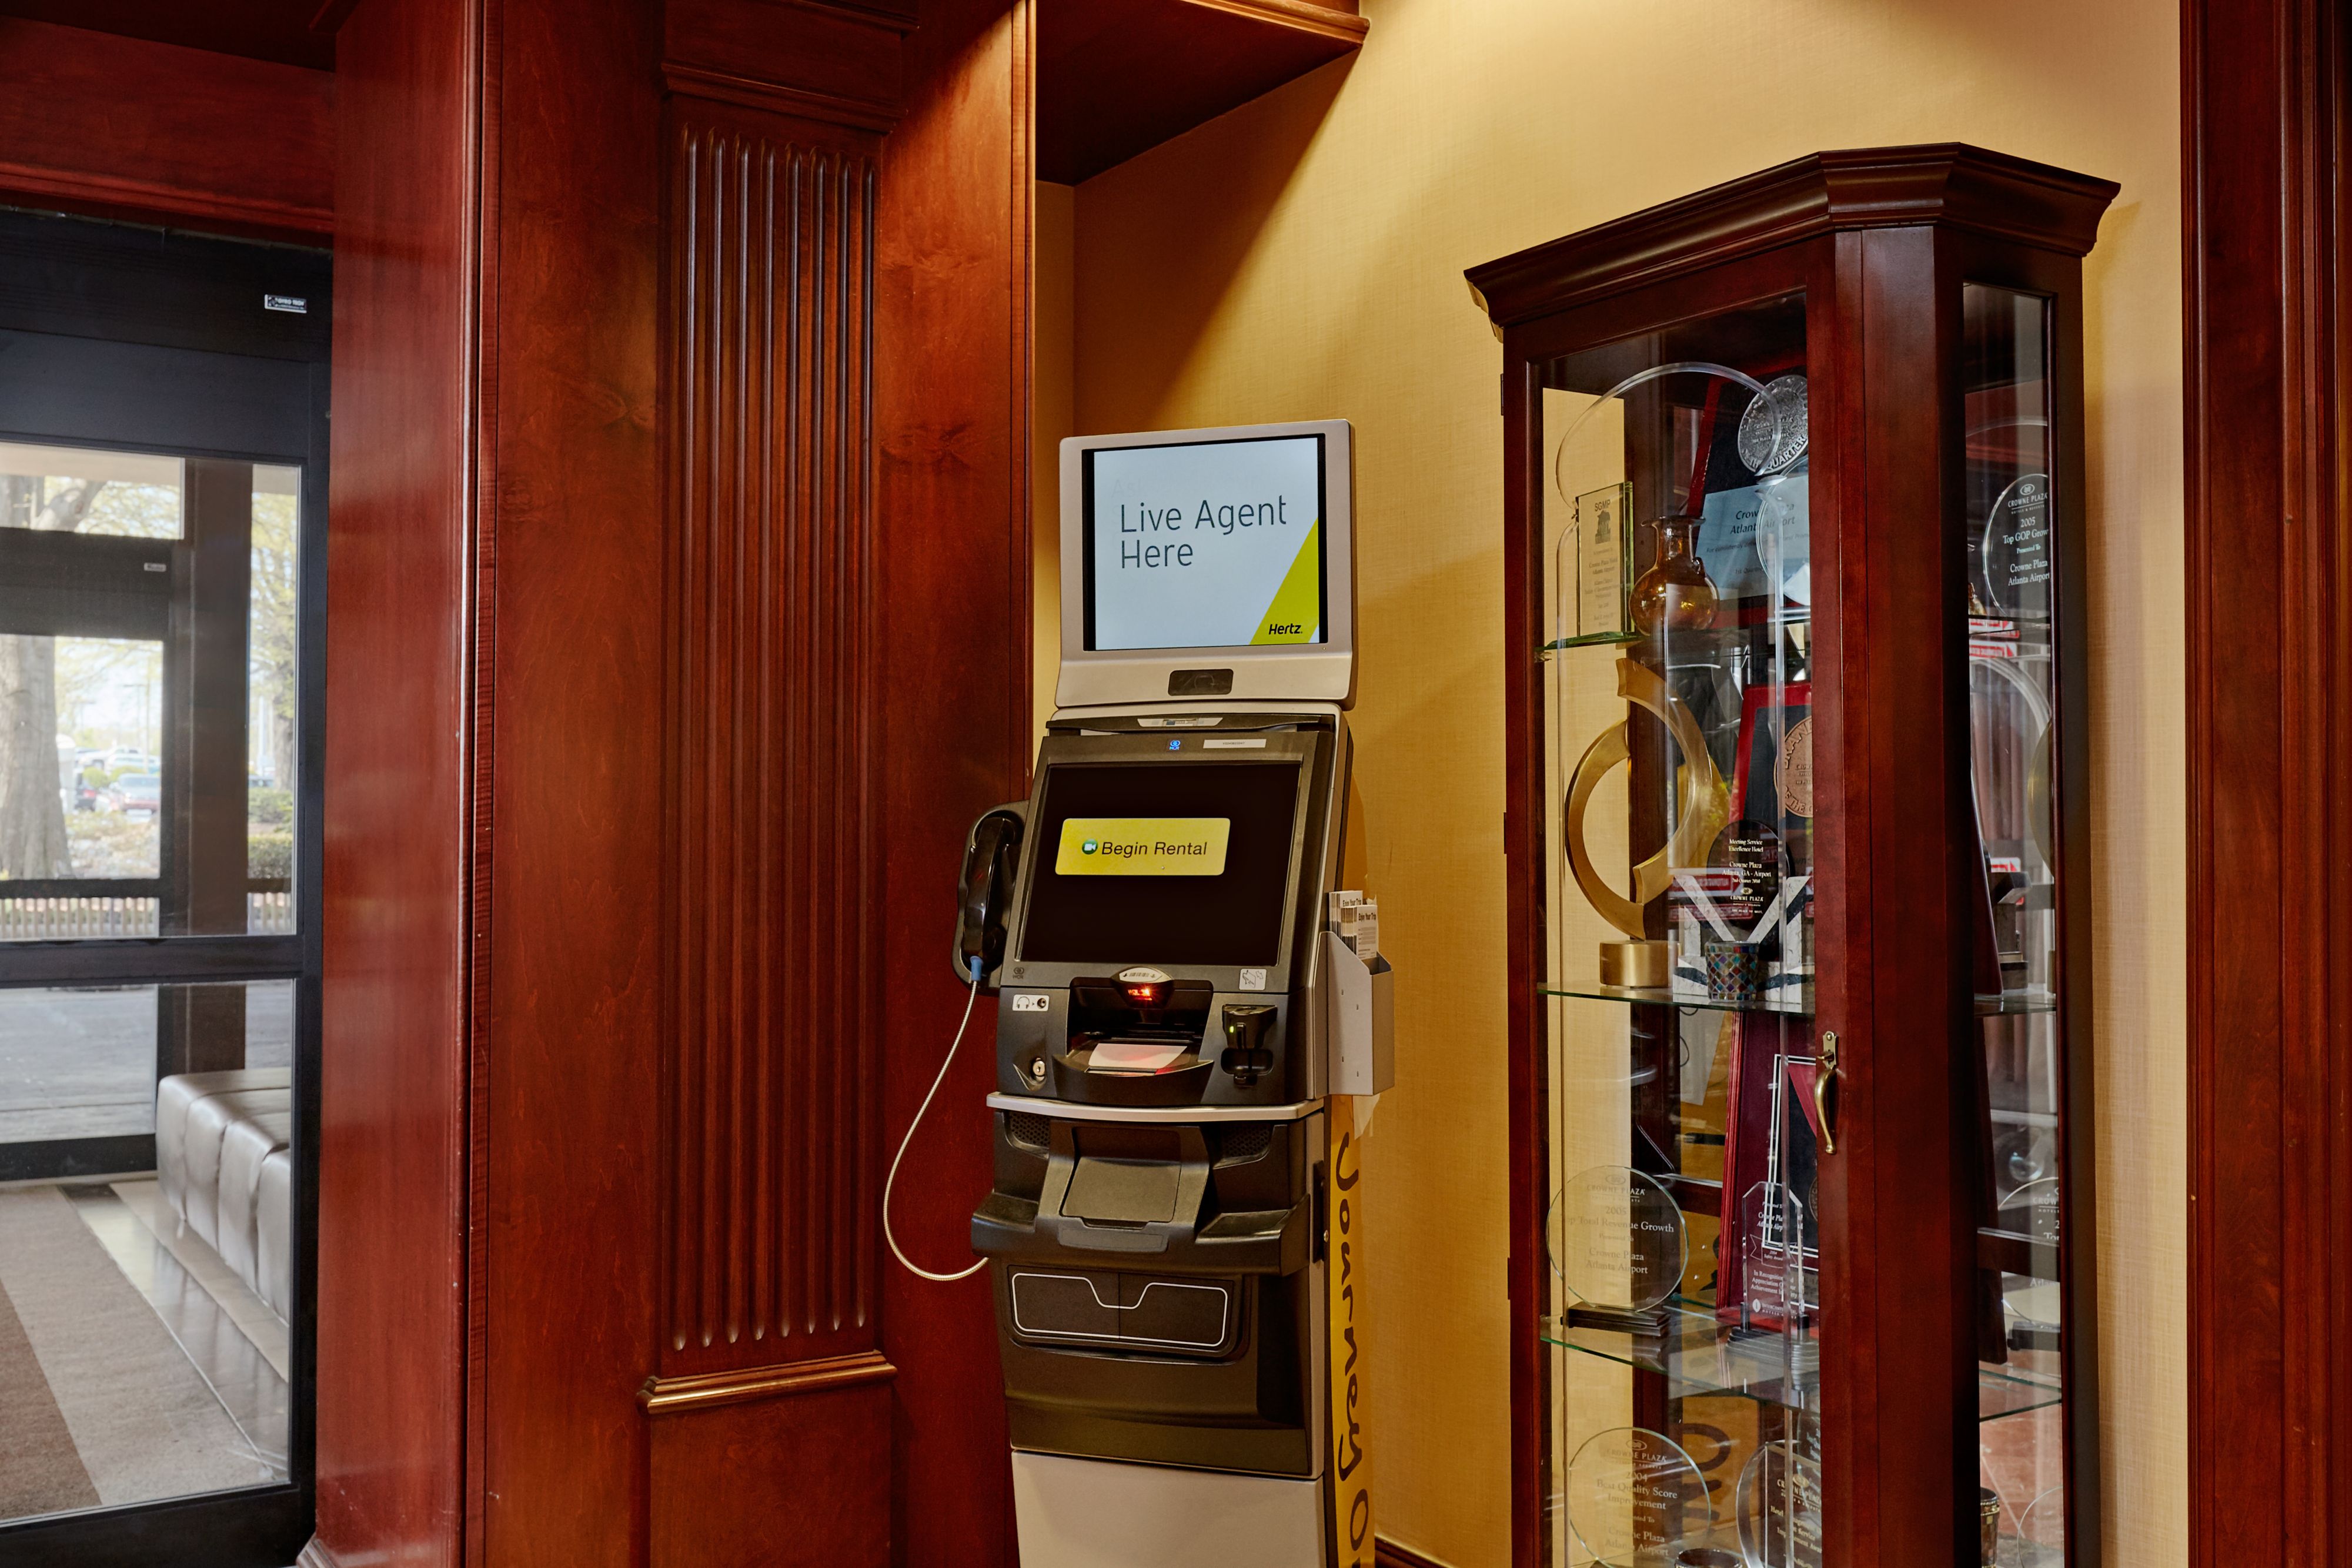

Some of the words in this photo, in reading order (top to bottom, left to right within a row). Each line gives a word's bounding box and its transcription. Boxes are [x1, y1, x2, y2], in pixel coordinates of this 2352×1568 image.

[1595, 499, 1611, 511] SGMP
[2008, 496, 2029, 507] CROWNE
[2031, 493, 2047, 503] PLAZA
[1121, 502, 1182, 533] Live
[1195, 495, 1287, 535] Agent
[2020, 517, 2036, 527] 2005
[2003, 535, 2014, 544] Top
[2015, 531, 2030, 541] GOP
[1121, 539, 1194, 569] Here
[2017, 546, 2034, 554] Presented
[2010, 563, 2032, 573] Crowne
[2033, 559, 2048, 569] Plaza
[2008, 575, 2028, 586] Atlanta
[2030, 572, 2050, 583] Airport
[1101, 842, 1148, 858] Begin
[1154, 842, 1207, 856] Rental
[1587, 1185, 1619, 1193] CROWNE
[1622, 1186, 1645, 1196] PLAZA
[1606, 1206, 1627, 1215] 2005
[1578, 1216, 1599, 1226] Total
[1602, 1218, 1638, 1229] Revenue
[1641, 1221, 1674, 1232] Growth
[1589, 1248, 1621, 1258] Crowne
[1586, 1260, 1615, 1271] Atlanta
[1335, 1131, 1363, 1482] Journey
[1642, 1452, 1666, 1462] PLAZA
[1626, 1472, 1647, 1482] 2004
[1597, 1479, 1618, 1489] Best
[1618, 1483, 1650, 1496] Quality
[1653, 1487, 1678, 1499] Score
[1608, 1493, 1666, 1510] Improvement
[1643, 1531, 1665, 1543] Plaza
